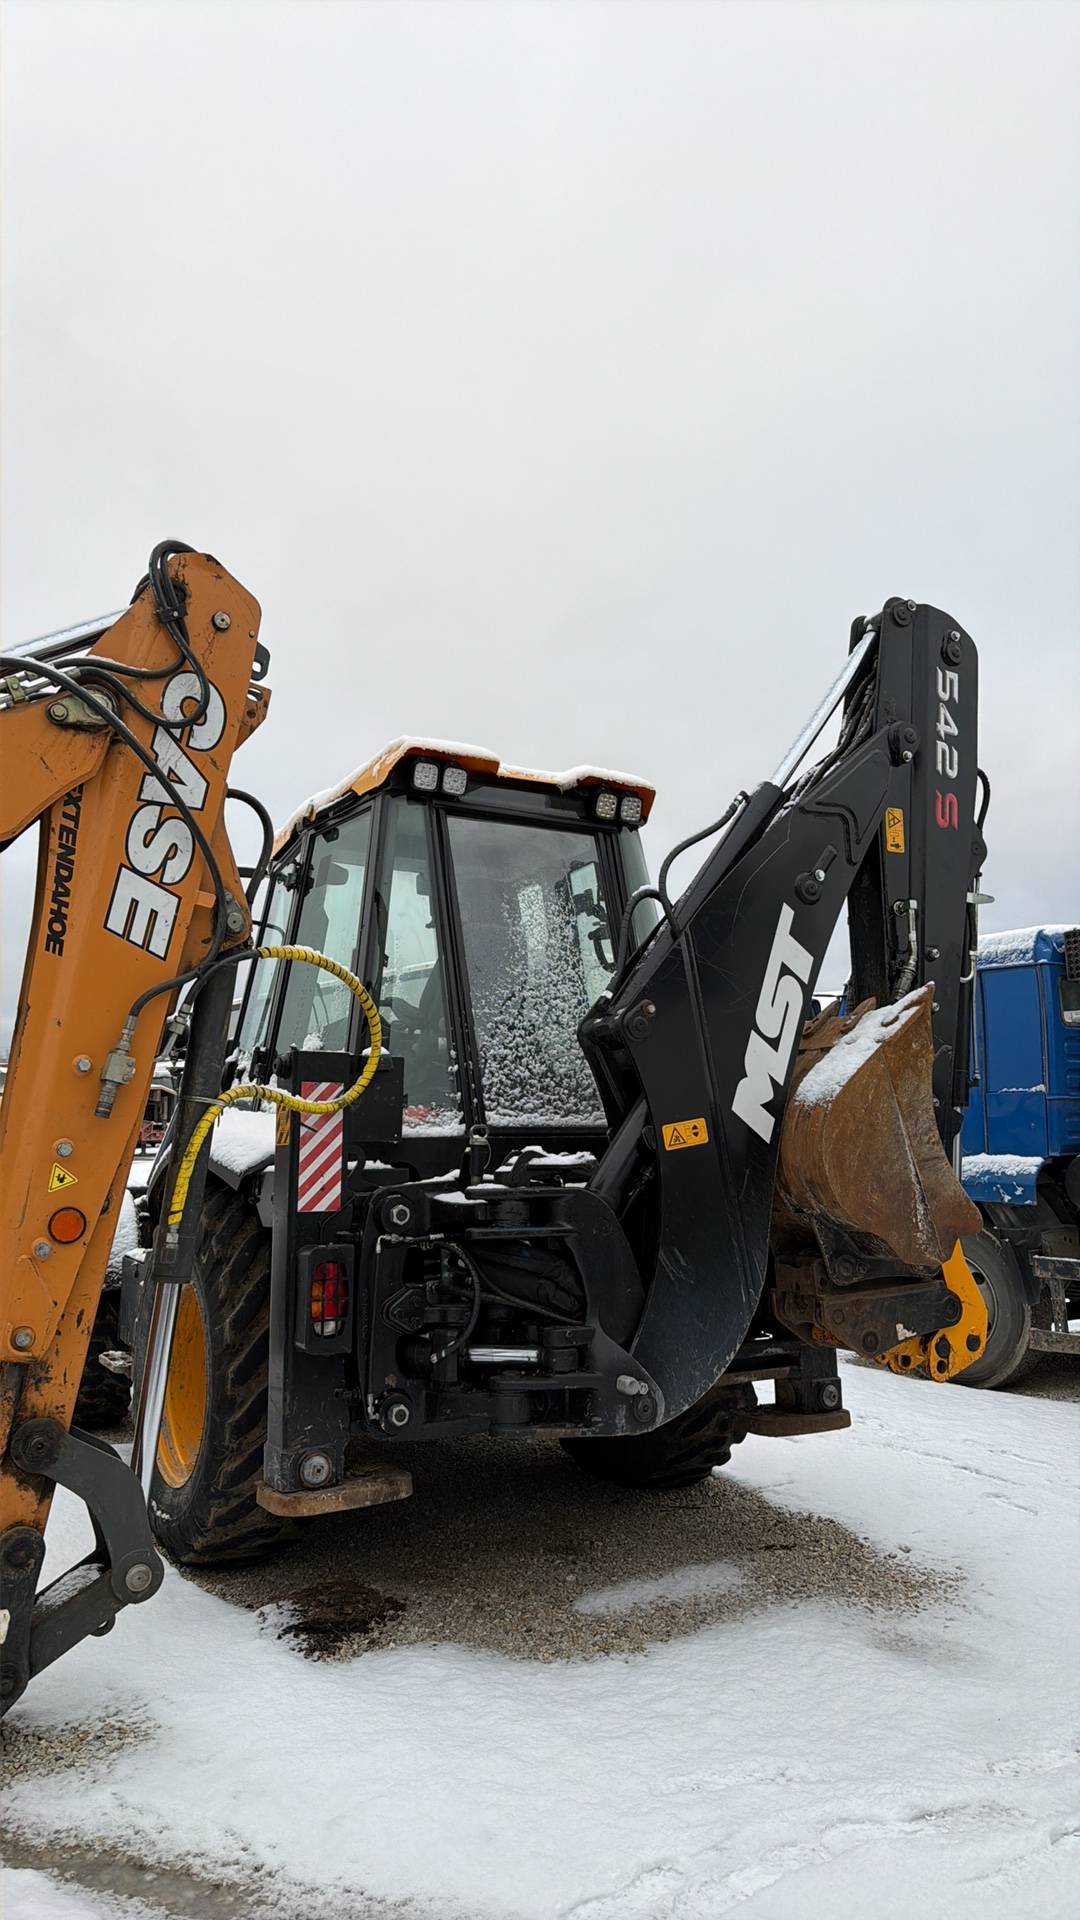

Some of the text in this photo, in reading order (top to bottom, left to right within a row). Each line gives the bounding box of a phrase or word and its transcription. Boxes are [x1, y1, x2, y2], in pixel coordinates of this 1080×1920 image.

[103, 670, 227, 962] CASE
[935, 666, 959, 832] 542 S
[732, 902, 815, 1144] MST
